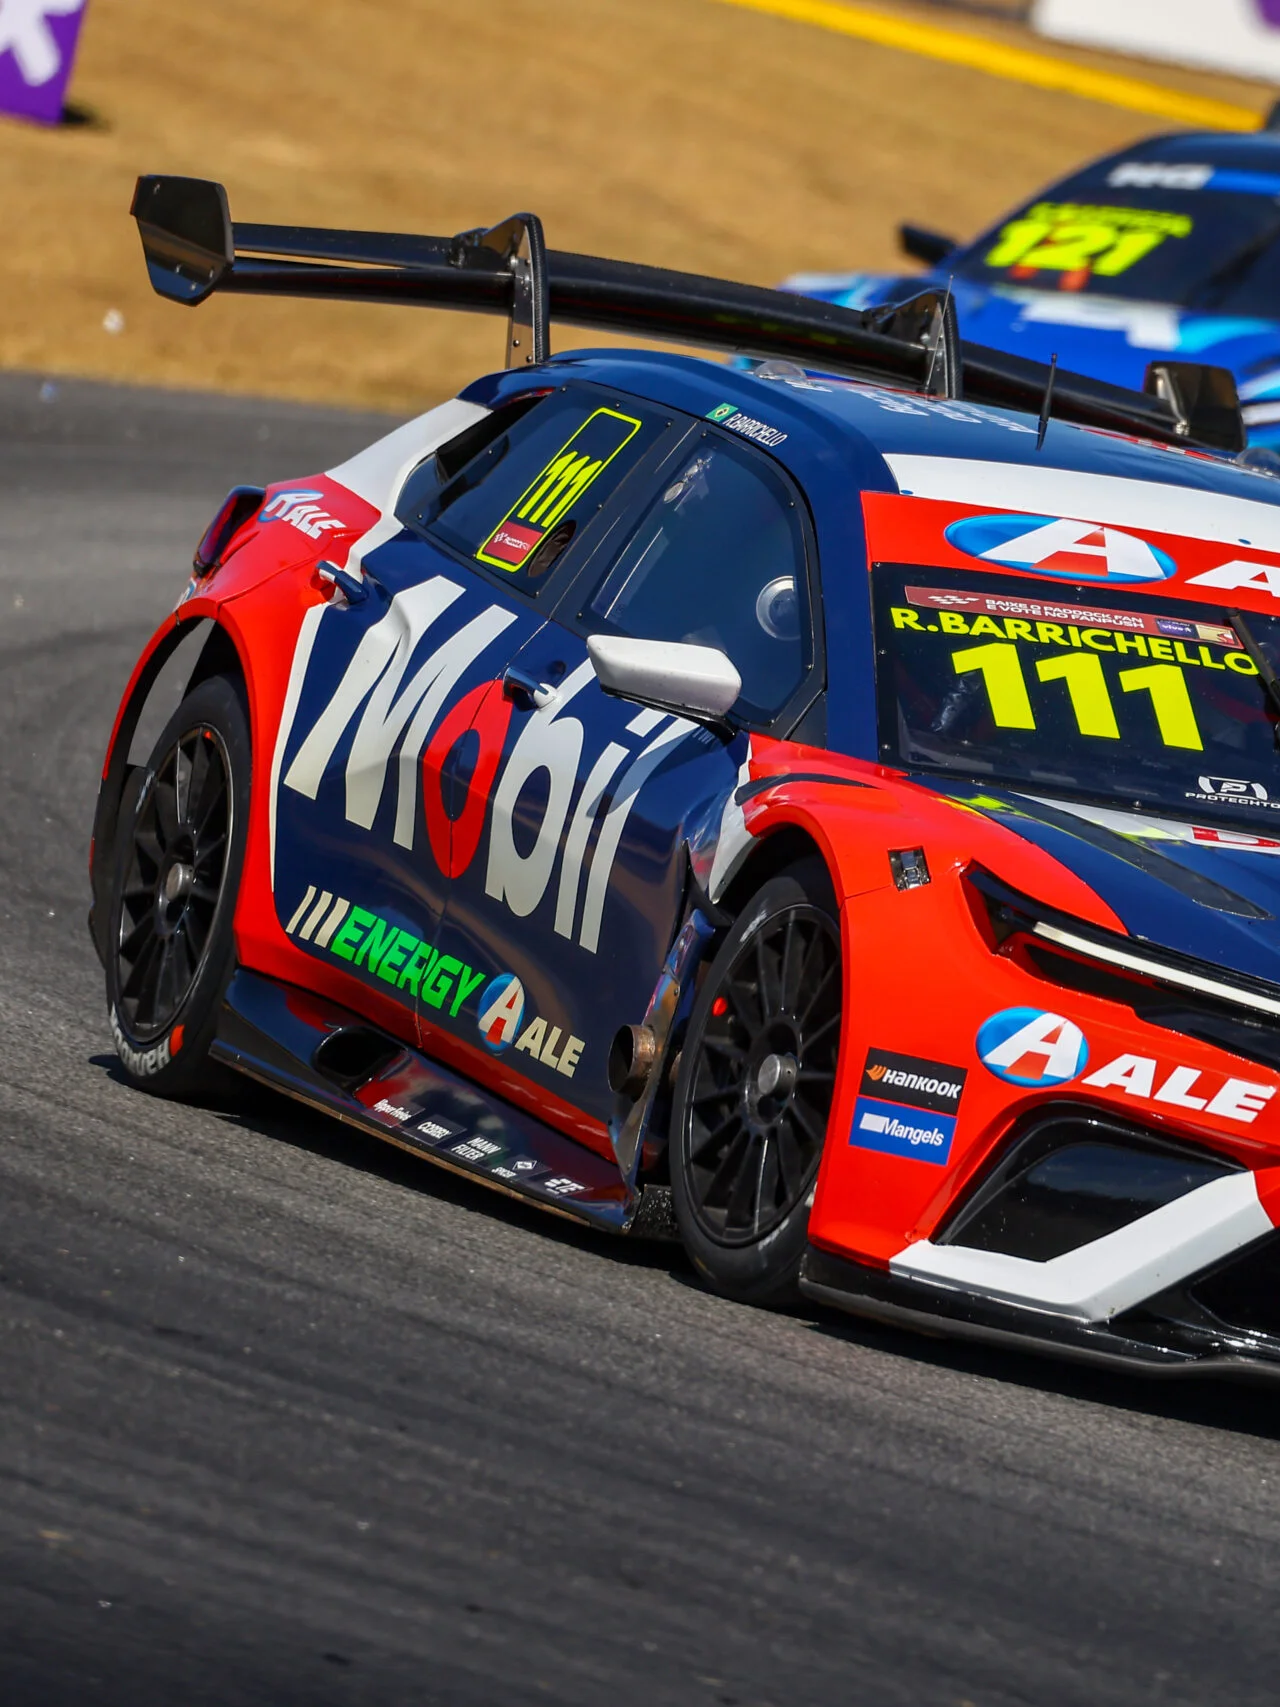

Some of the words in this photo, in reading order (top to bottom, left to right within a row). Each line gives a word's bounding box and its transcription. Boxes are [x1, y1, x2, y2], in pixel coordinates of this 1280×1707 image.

[984, 219, 1166, 276] 121
[517, 451, 603, 528] 111
[282, 505, 346, 540] ALE
[891, 607, 1260, 676] R.BARRICHELLO
[997, 605, 1042, 616] VOTE
[1044, 610, 1068, 619] NO
[1043, 606, 1111, 620] PADDOCK
[1113, 615, 1143, 623] FAN
[952, 642, 1204, 751] 111
[284, 575, 700, 954] Mobil
[330, 905, 486, 1018] ENERGY
[514, 1016, 586, 1078] ALE
[1081, 1053, 1277, 1123] ALE
[450, 1143, 485, 1161] FILTER
[467, 1137, 501, 1154] MANN
[884, 1118, 945, 1146] Mangels
